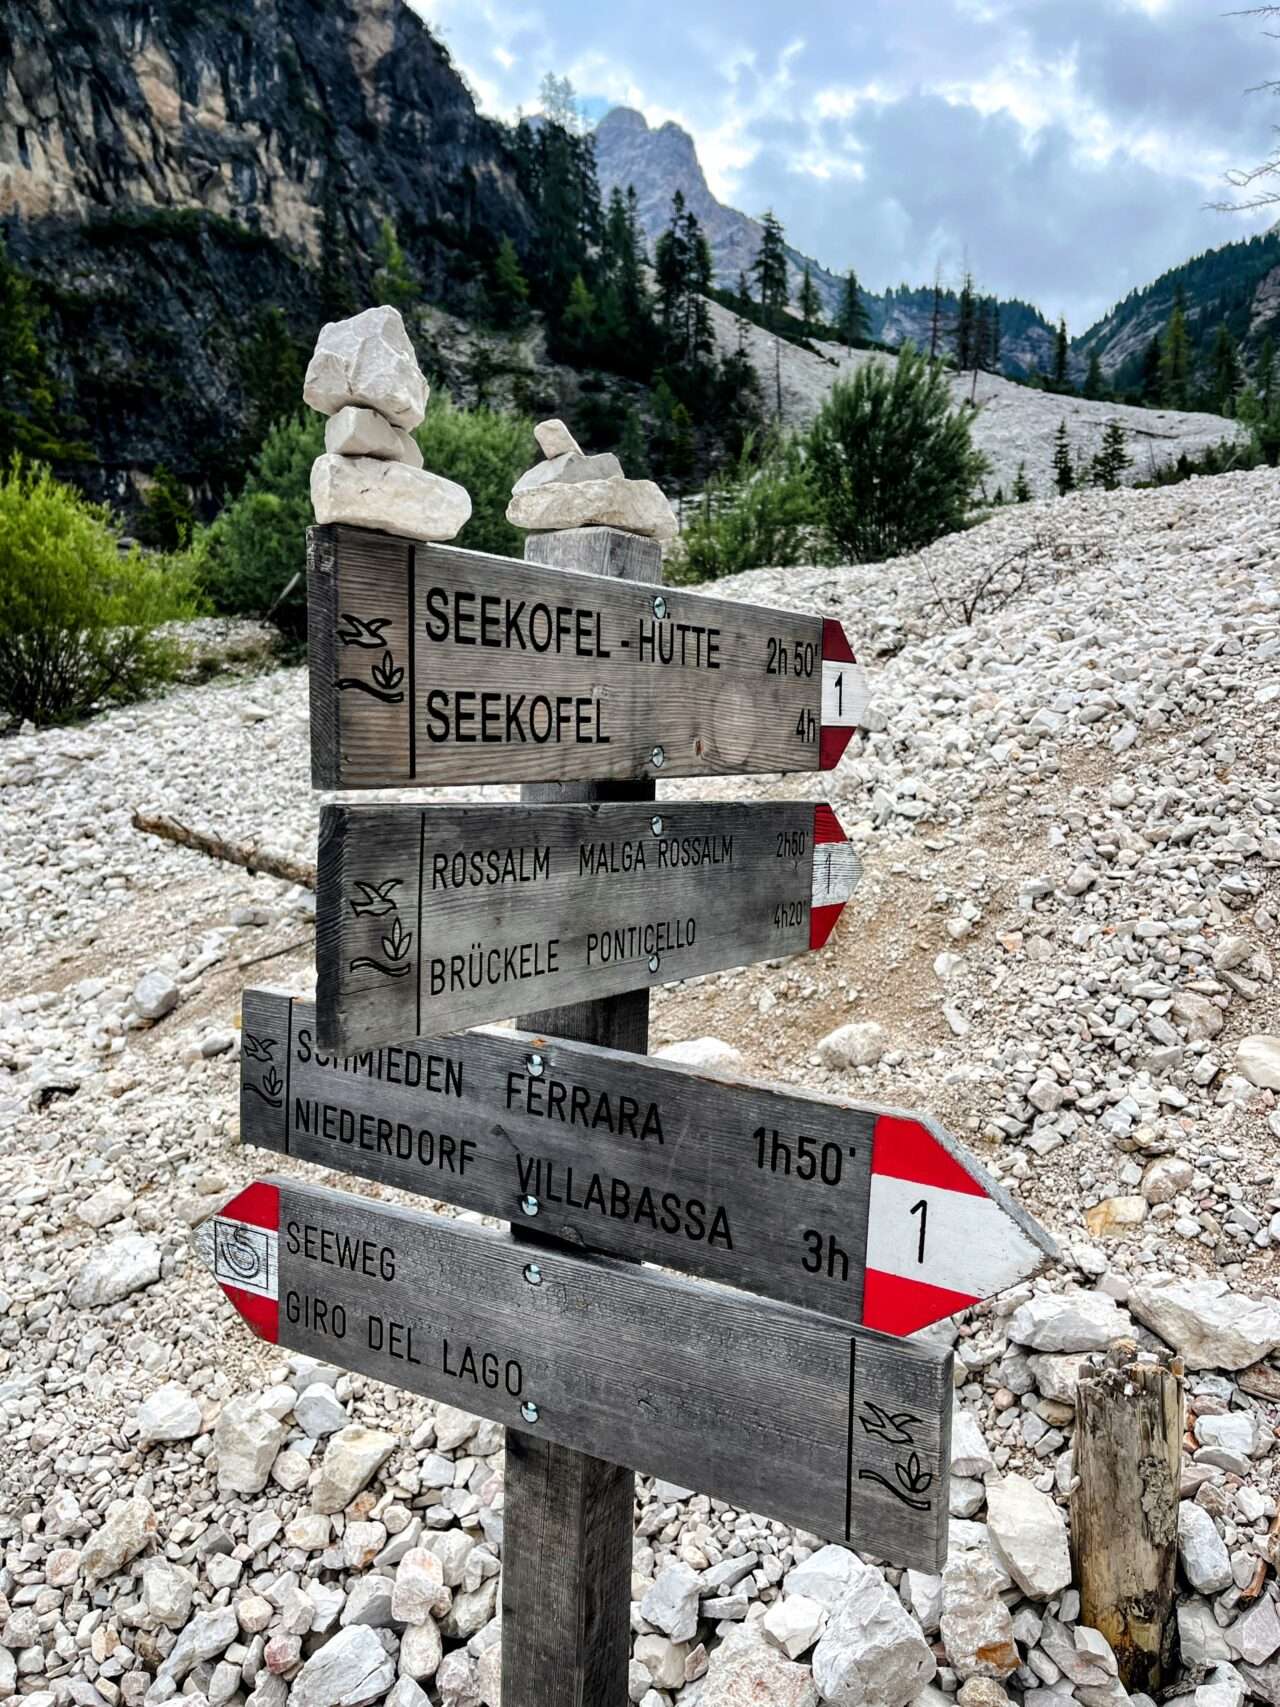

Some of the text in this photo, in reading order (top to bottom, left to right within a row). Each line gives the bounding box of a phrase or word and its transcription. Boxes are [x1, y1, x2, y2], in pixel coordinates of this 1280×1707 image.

[426, 689, 816, 743] SEEKOFEL 4h
[834, 671, 844, 717] 1
[432, 846, 551, 890] ROSSALM
[579, 843, 647, 876] MALGA
[658, 835, 733, 869] ROSSALM
[825, 853, 832, 894] 1
[430, 939, 560, 996] BRÜCKELE
[587, 918, 696, 966] PONTICELLO
[506, 1072, 665, 1145] FERRARA
[295, 1098, 849, 1281] NIEDERDORF VILLABASSA 3h
[286, 1221, 396, 1282] SEEWEG
[910, 1199, 928, 1264] 1
[286, 1290, 523, 1397] GIRO DEL LAGO
